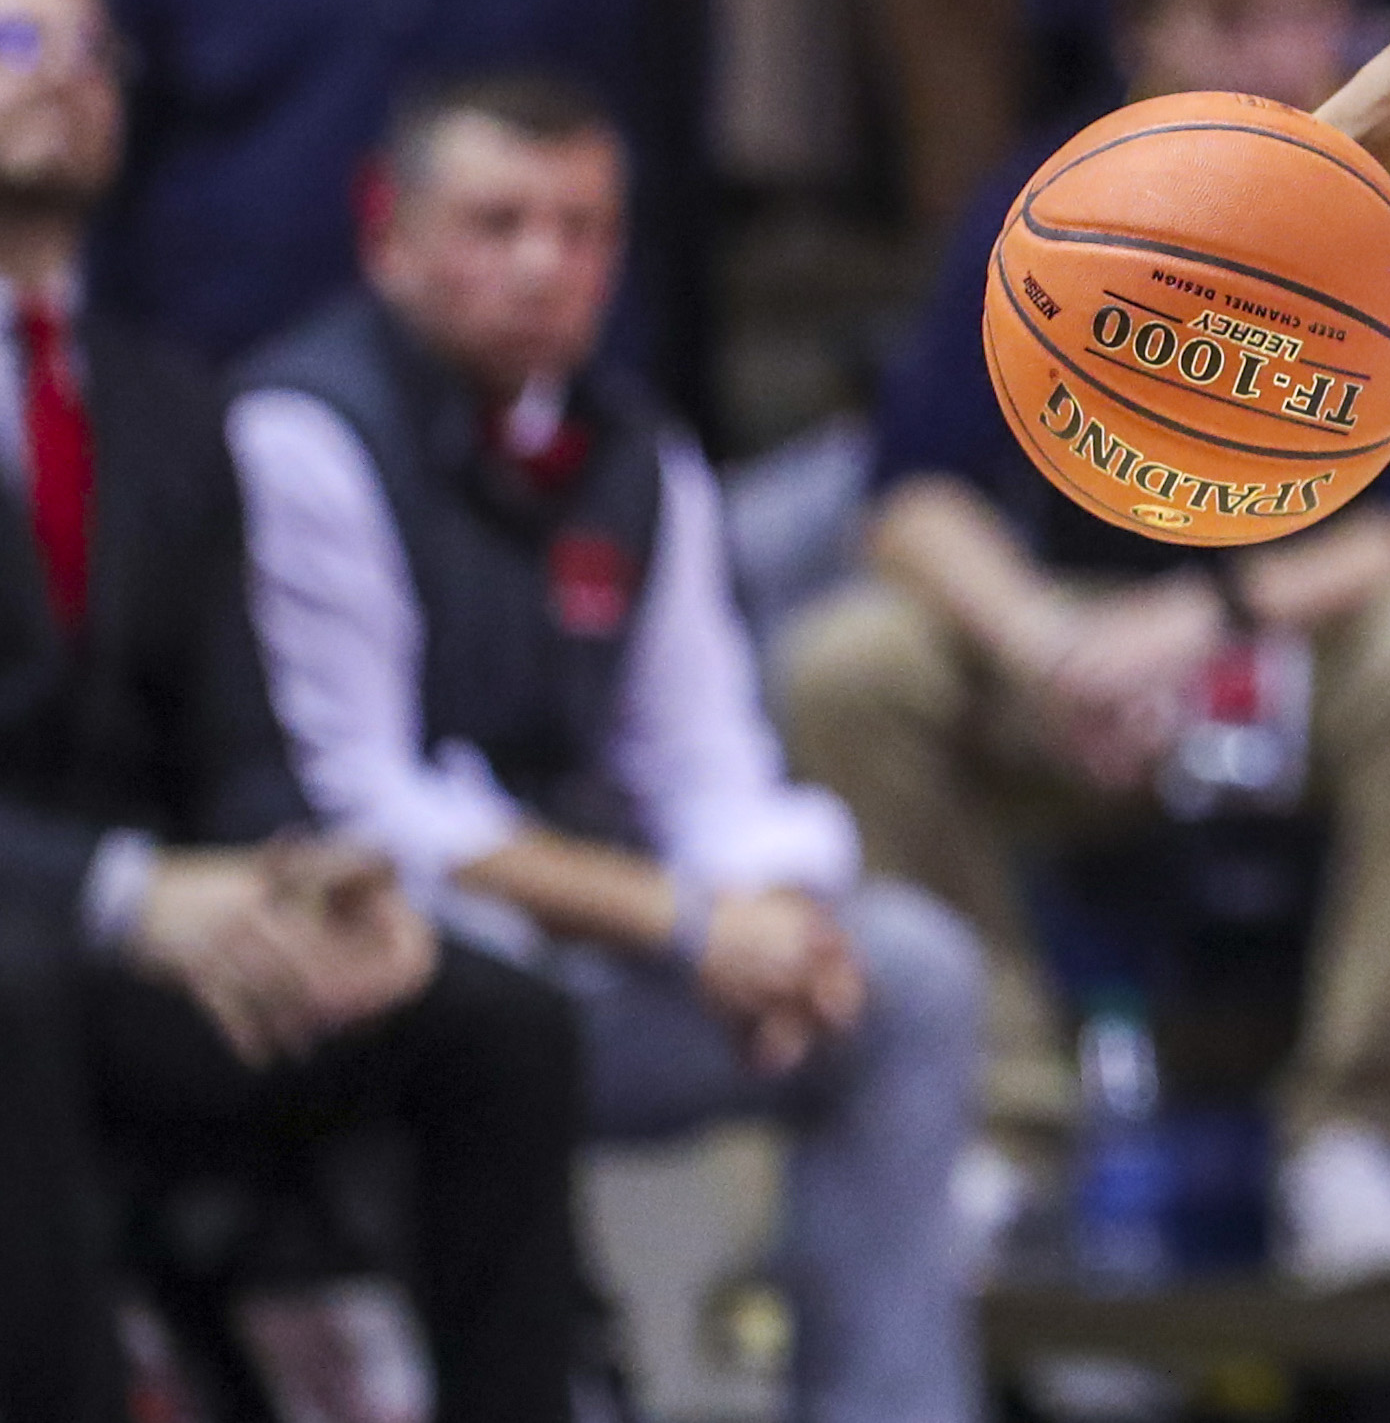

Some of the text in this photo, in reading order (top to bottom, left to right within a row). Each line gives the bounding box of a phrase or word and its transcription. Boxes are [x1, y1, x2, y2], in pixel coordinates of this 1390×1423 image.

[1151, 269, 1347, 342] DEEP CHANNEL DESIGN
[1188, 309, 1303, 361] LEGACY
[1091, 304, 1363, 429] TF-1000
[1039, 381, 1336, 517] SPALDING
